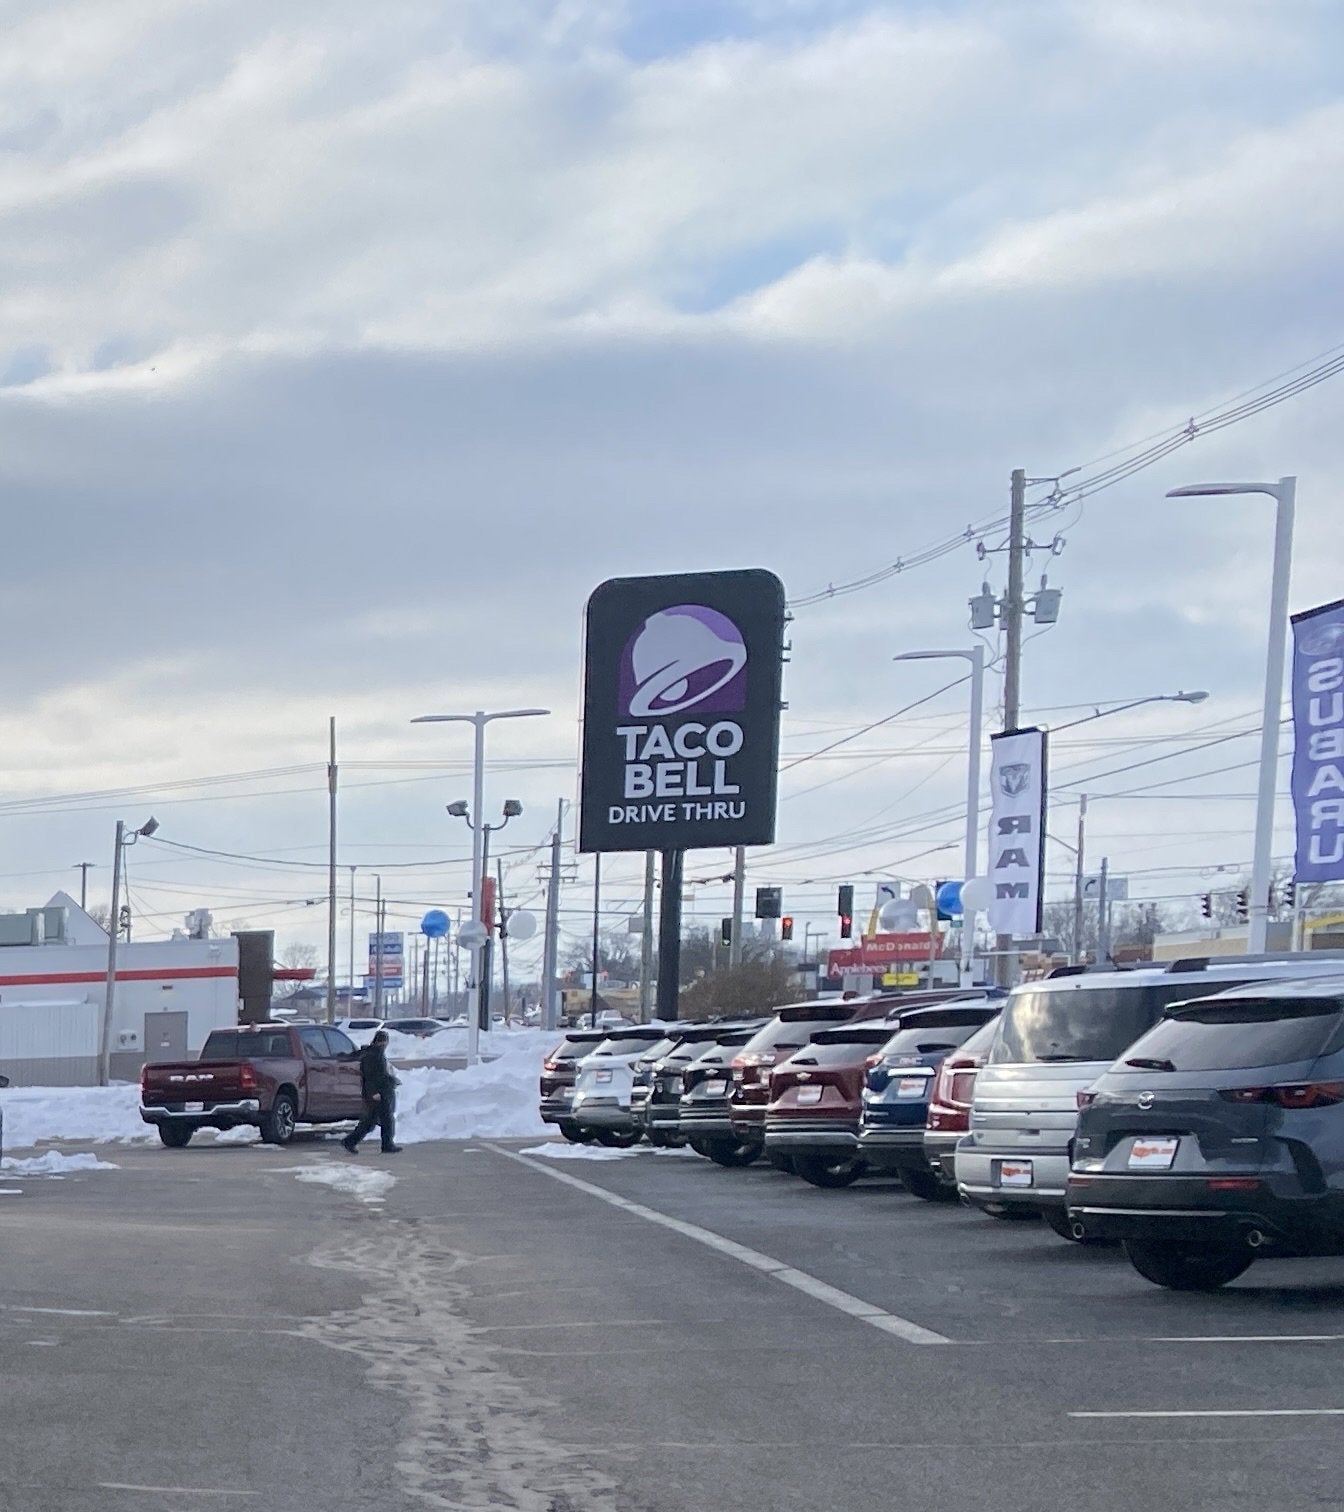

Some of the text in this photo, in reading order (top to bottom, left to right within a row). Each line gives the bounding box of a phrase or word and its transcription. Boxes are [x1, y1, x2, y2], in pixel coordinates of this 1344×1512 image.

[616, 721, 744, 761] TACO
[624, 760, 740, 798] BELL
[608, 801, 746, 824] DRIVE THRU
[866, 941, 940, 952] McDonalds
